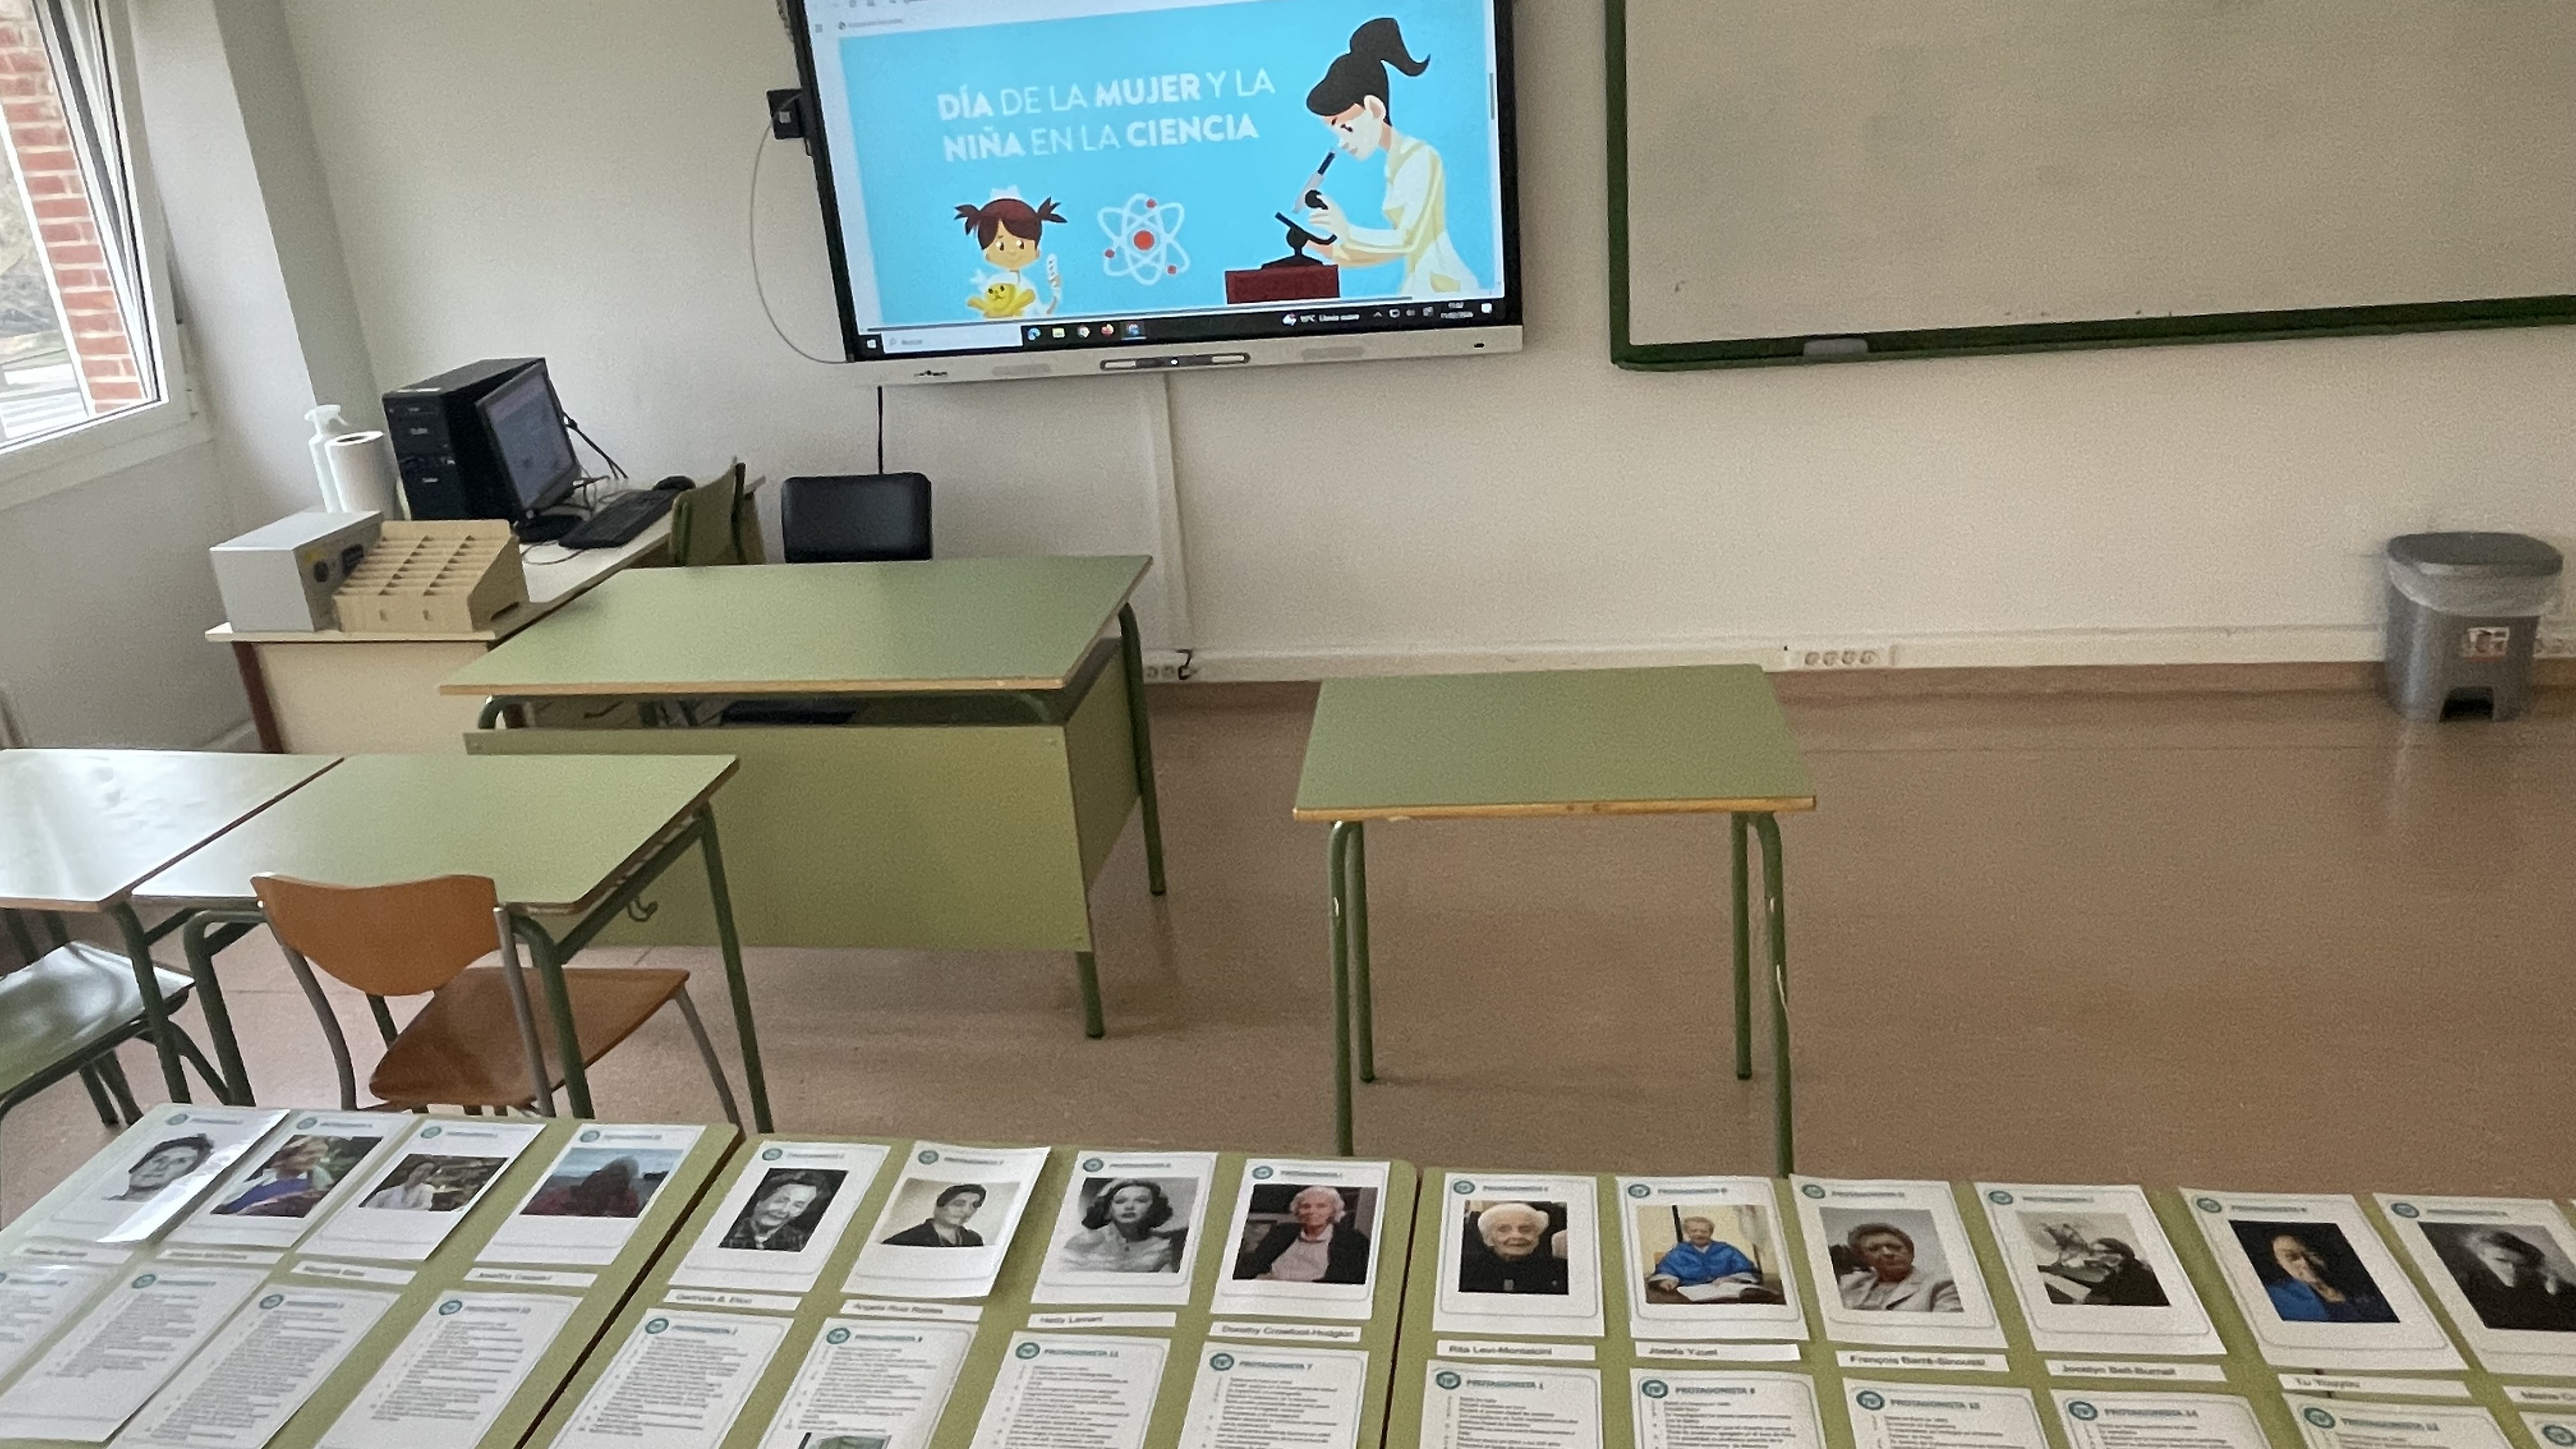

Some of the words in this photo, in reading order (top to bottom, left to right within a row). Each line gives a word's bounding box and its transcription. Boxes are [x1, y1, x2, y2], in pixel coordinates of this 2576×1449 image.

[937, 84, 994, 120] DÍA
[1000, 87, 1041, 116] DE
[1049, 82, 1089, 111] LA
[1095, 72, 1201, 108] MUJER
[1206, 70, 1227, 98] Y
[1236, 67, 1276, 97] LA
[944, 125, 1026, 163] NIÑA
[1031, 126, 1073, 156] EN
[1080, 123, 1121, 151] LA
[1126, 113, 1260, 147] CIENCIA
